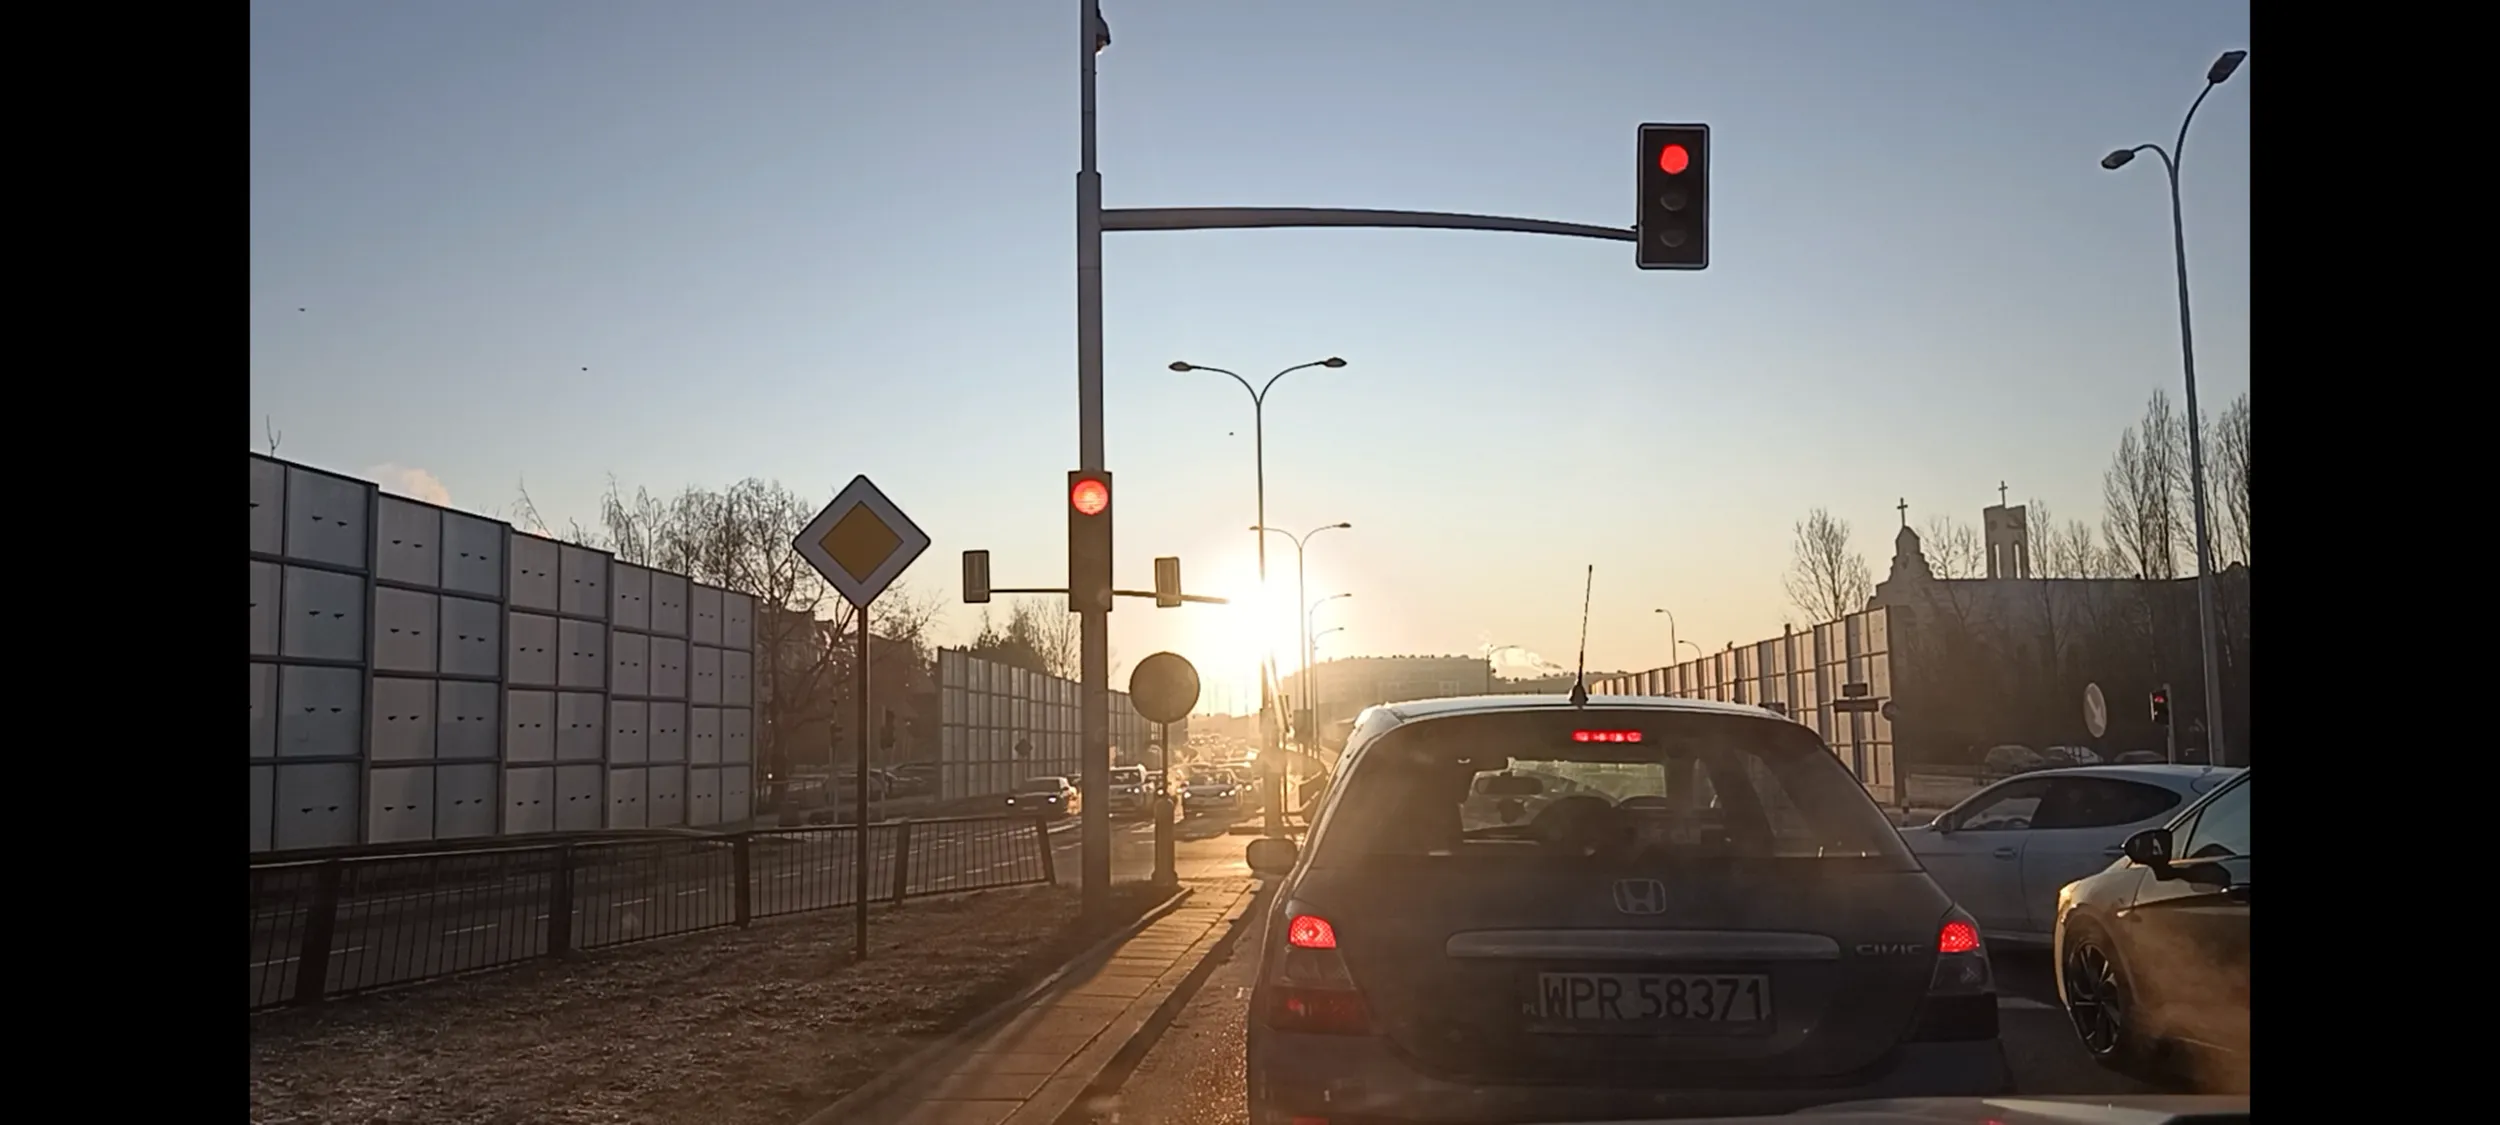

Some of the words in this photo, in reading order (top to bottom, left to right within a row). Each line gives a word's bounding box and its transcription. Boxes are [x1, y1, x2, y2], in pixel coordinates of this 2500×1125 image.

[1855, 943, 1923, 955] CIVIC
[1544, 977, 1623, 1020] WPR
[1639, 978, 1762, 1021] 58371
